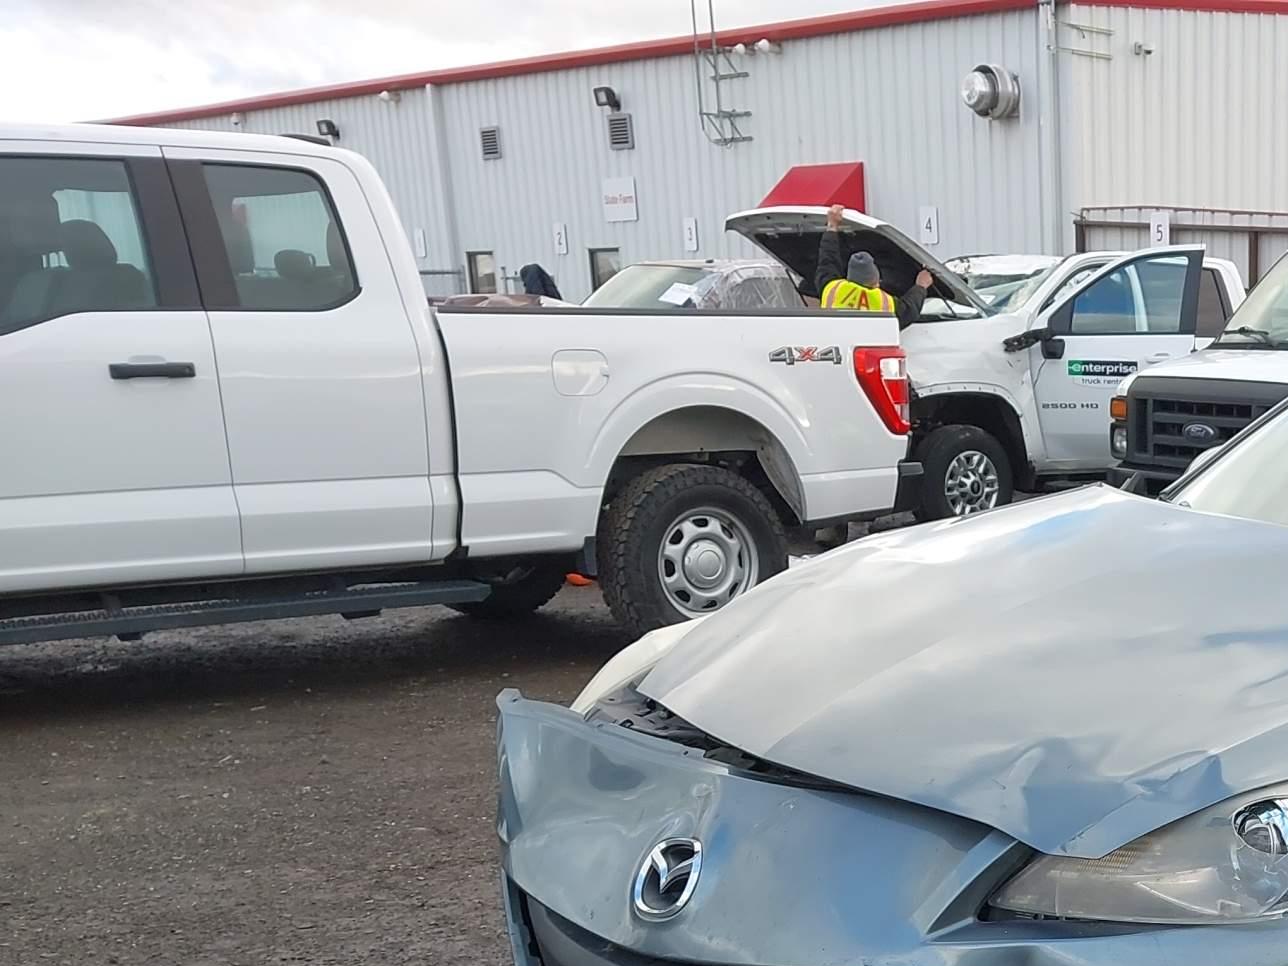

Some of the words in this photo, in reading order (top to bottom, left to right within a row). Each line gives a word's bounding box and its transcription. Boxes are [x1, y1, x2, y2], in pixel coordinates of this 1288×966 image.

[924, 217, 933, 232] 4
[556, 231, 562, 246] 2
[1156, 224, 1164, 242] 5
[1068, 362, 1137, 374] enterprise
